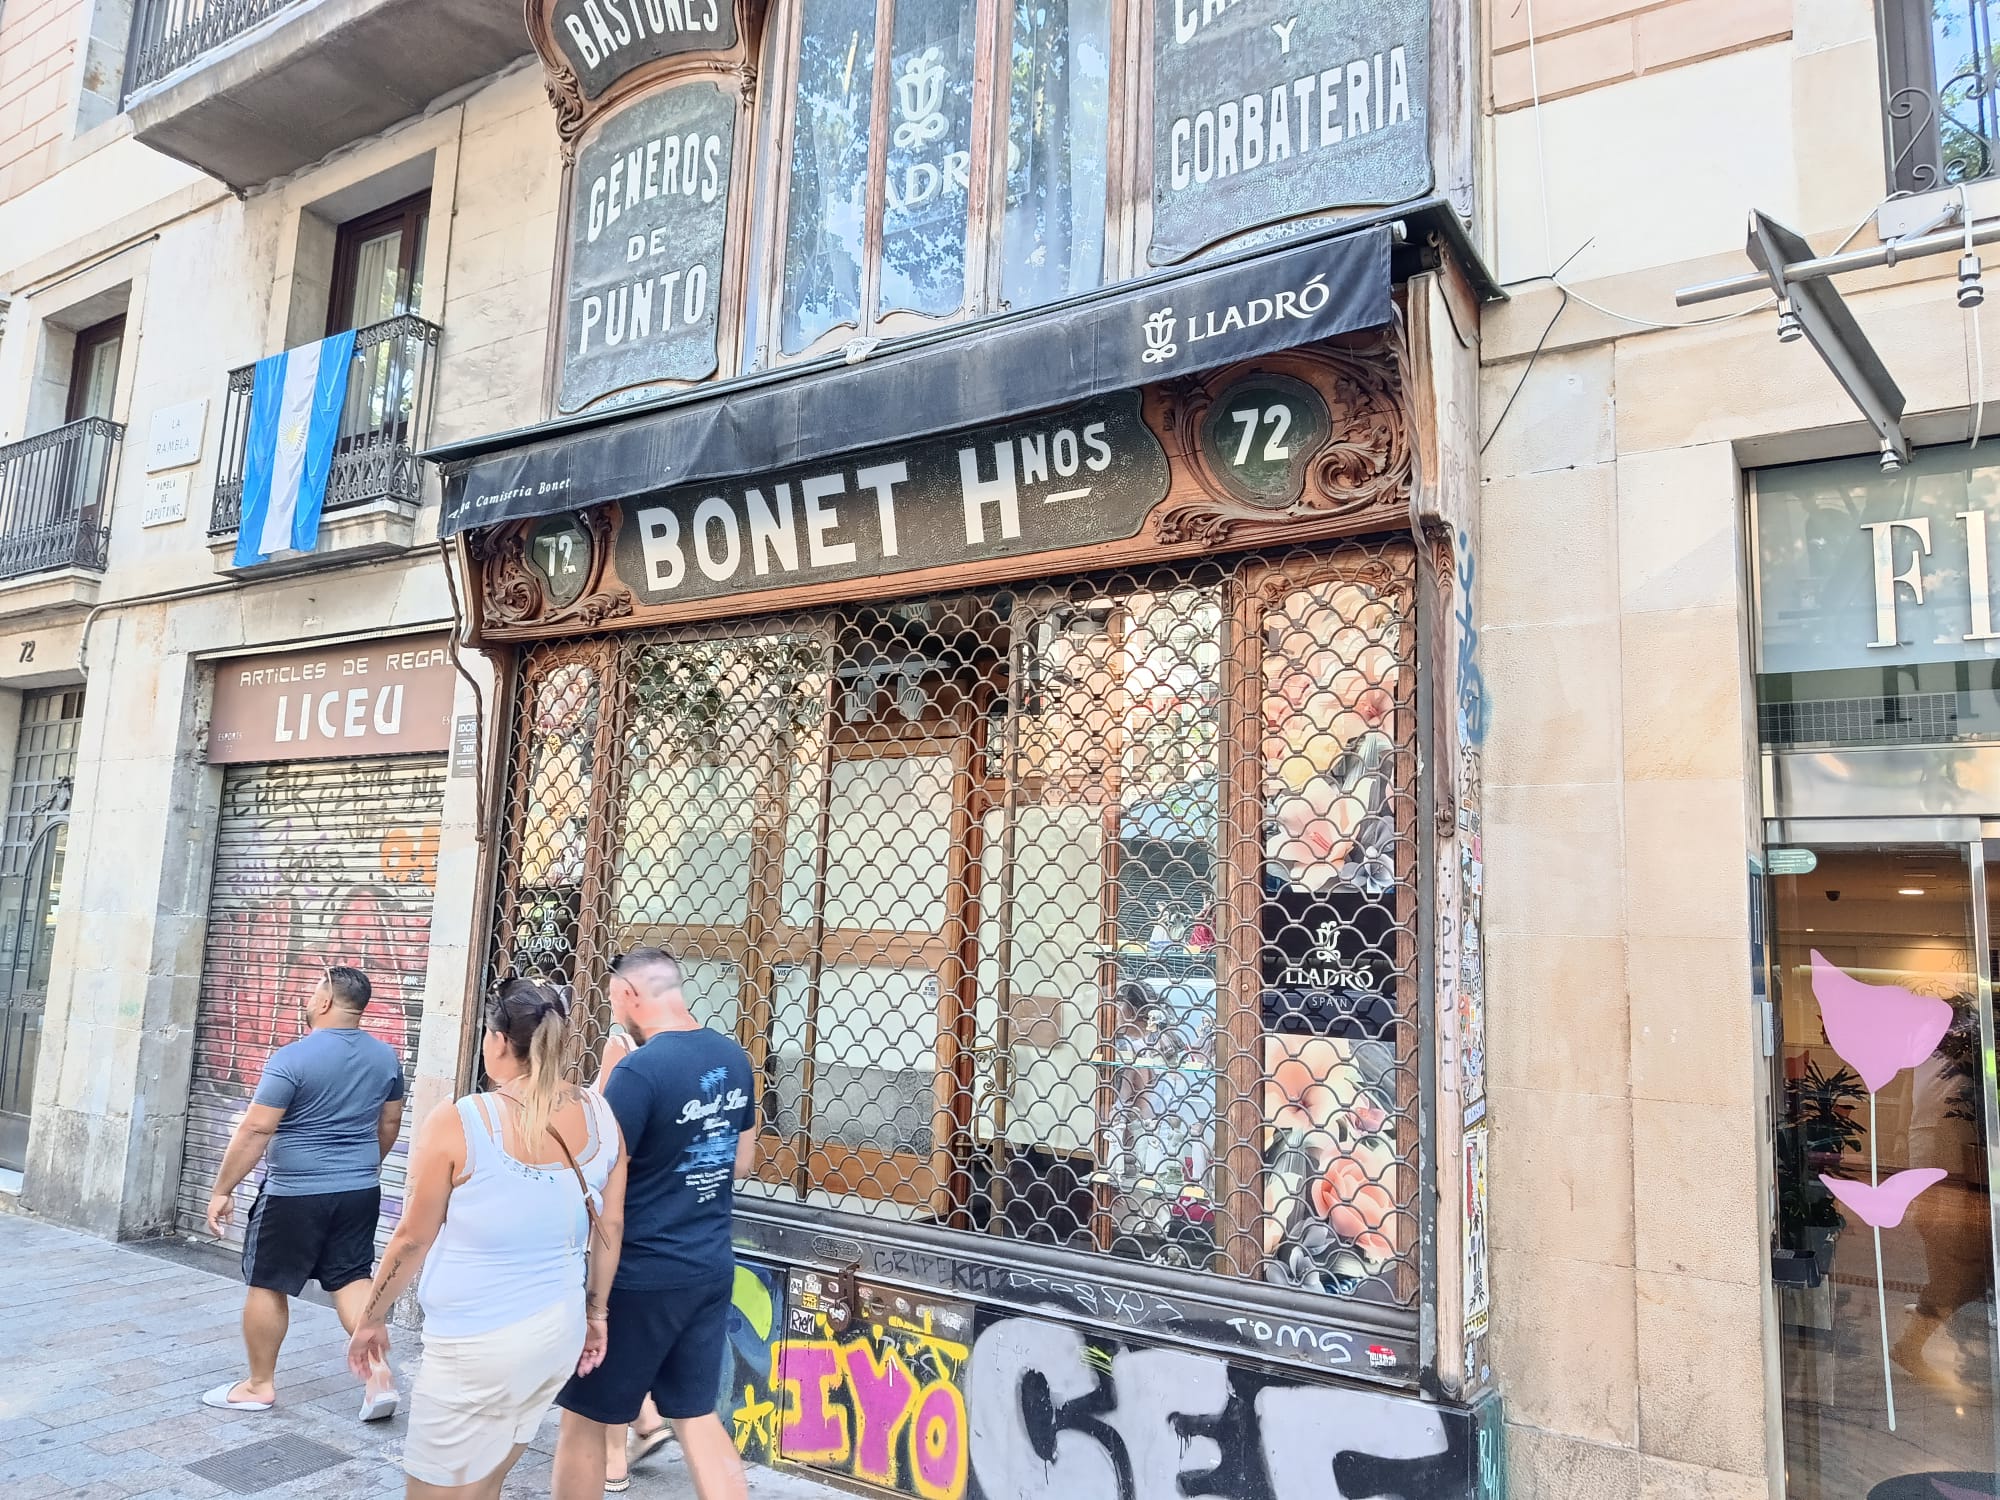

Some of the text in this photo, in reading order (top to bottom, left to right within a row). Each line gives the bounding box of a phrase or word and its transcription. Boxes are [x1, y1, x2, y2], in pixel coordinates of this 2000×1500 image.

[1272, 15, 1299, 54] Y
[1171, 46, 1411, 191] CORBATERIA
[587, 132, 720, 243] GÉNEROS
[626, 227, 667, 263] DE
[579, 263, 708, 354] PUNTO
[1187, 273, 1330, 343] LLADRÓ
[156, 437, 190, 456] RAMBLA
[1231, 404, 1291, 466] 72
[476, 485, 532, 507] Camiseria
[538, 478, 570, 495] Bonet
[637, 461, 907, 591] BONET
[542, 534, 577, 577] 72
[19, 640, 36, 663] 72
[342, 657, 369, 676] DE
[275, 684, 404, 742] LICEU
[1285, 965, 1374, 991] LLADRÓ
